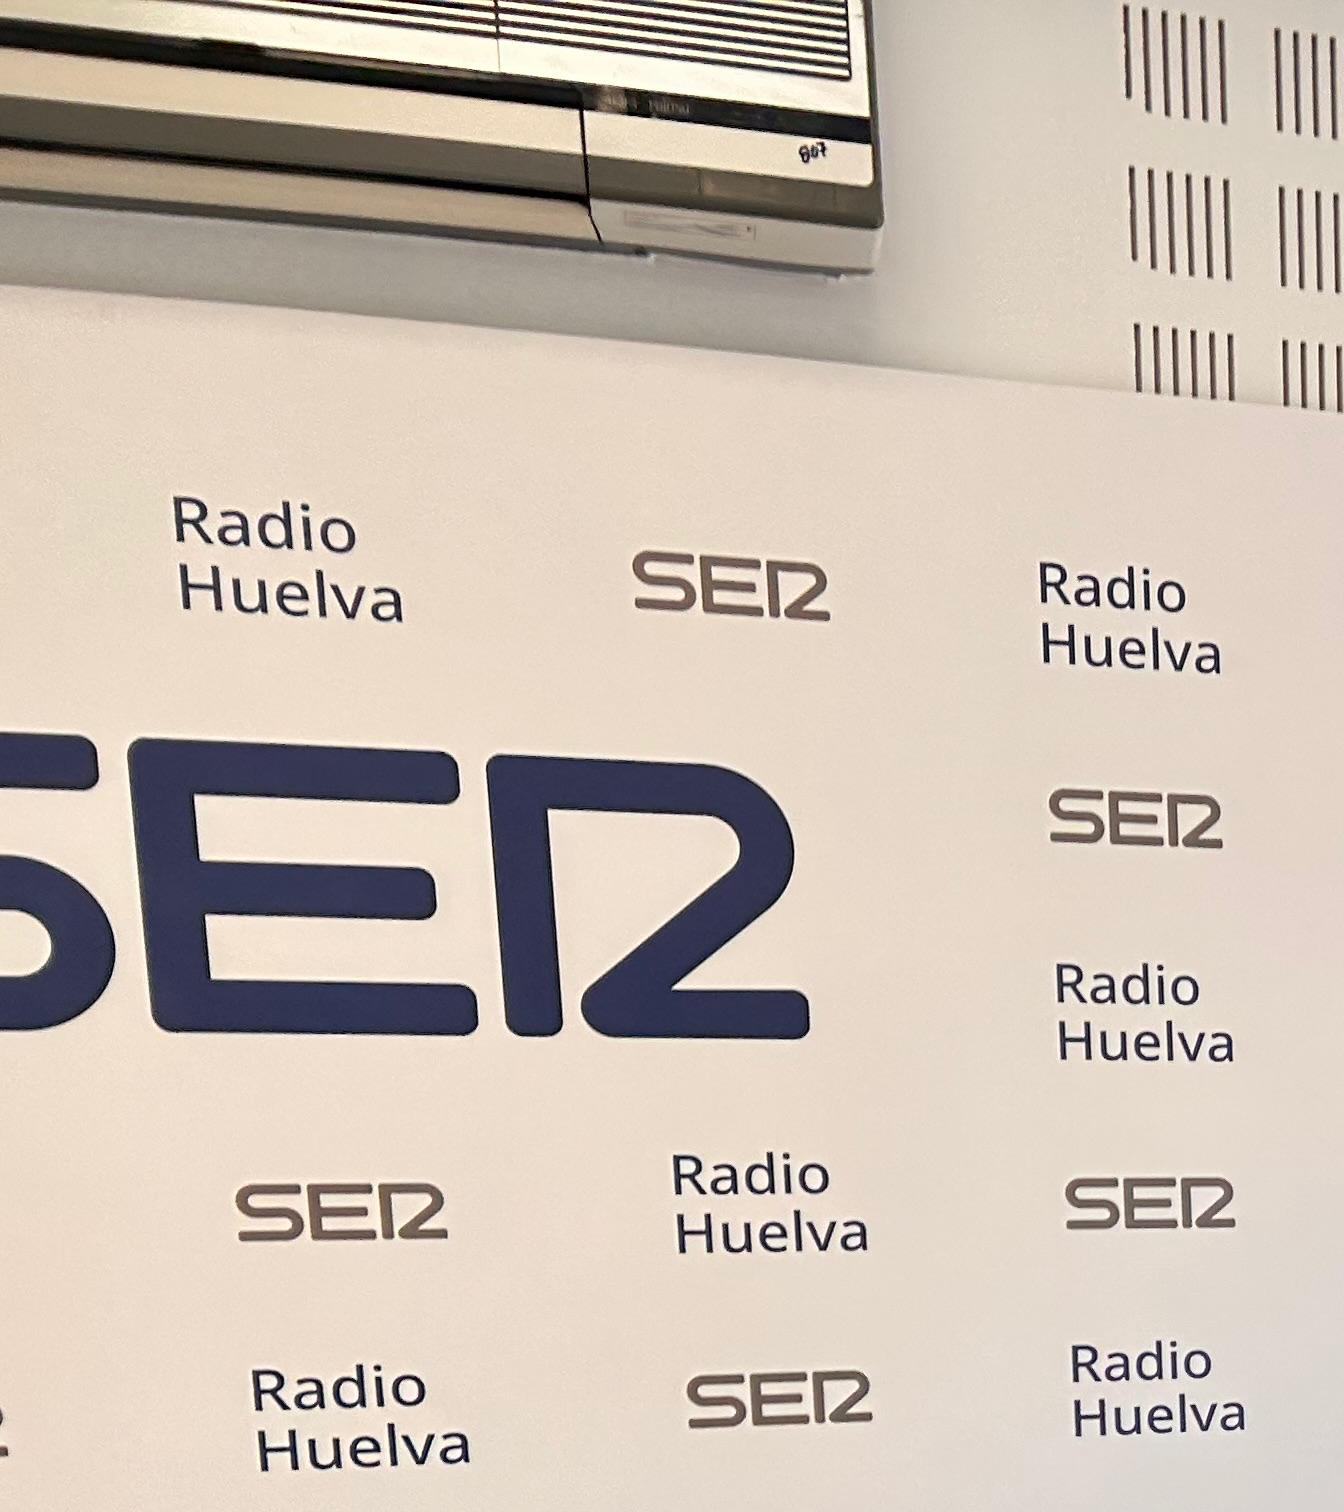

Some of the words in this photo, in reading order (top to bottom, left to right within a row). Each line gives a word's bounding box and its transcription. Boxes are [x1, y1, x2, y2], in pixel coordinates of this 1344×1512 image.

[171, 494, 358, 556] Radio
[177, 561, 405, 625] Huelva
[630, 548, 832, 624] SER
[1038, 559, 1187, 615] Radio
[1040, 620, 1222, 677] Huelva
[1047, 786, 1225, 851] SER
[1054, 961, 1201, 1008] Radio
[1057, 1018, 1235, 1064] Huelva
[671, 1150, 831, 1197] Radio
[233, 1181, 450, 1244] SER
[675, 1207, 869, 1256] Huelva
[1063, 1175, 1238, 1232] SER
[250, 1362, 428, 1414] Radio
[1070, 1338, 1213, 1384] Radio
[685, 1368, 875, 1431] SER
[1072, 1391, 1247, 1439] Huelva
[256, 1421, 472, 1474] Huelva
